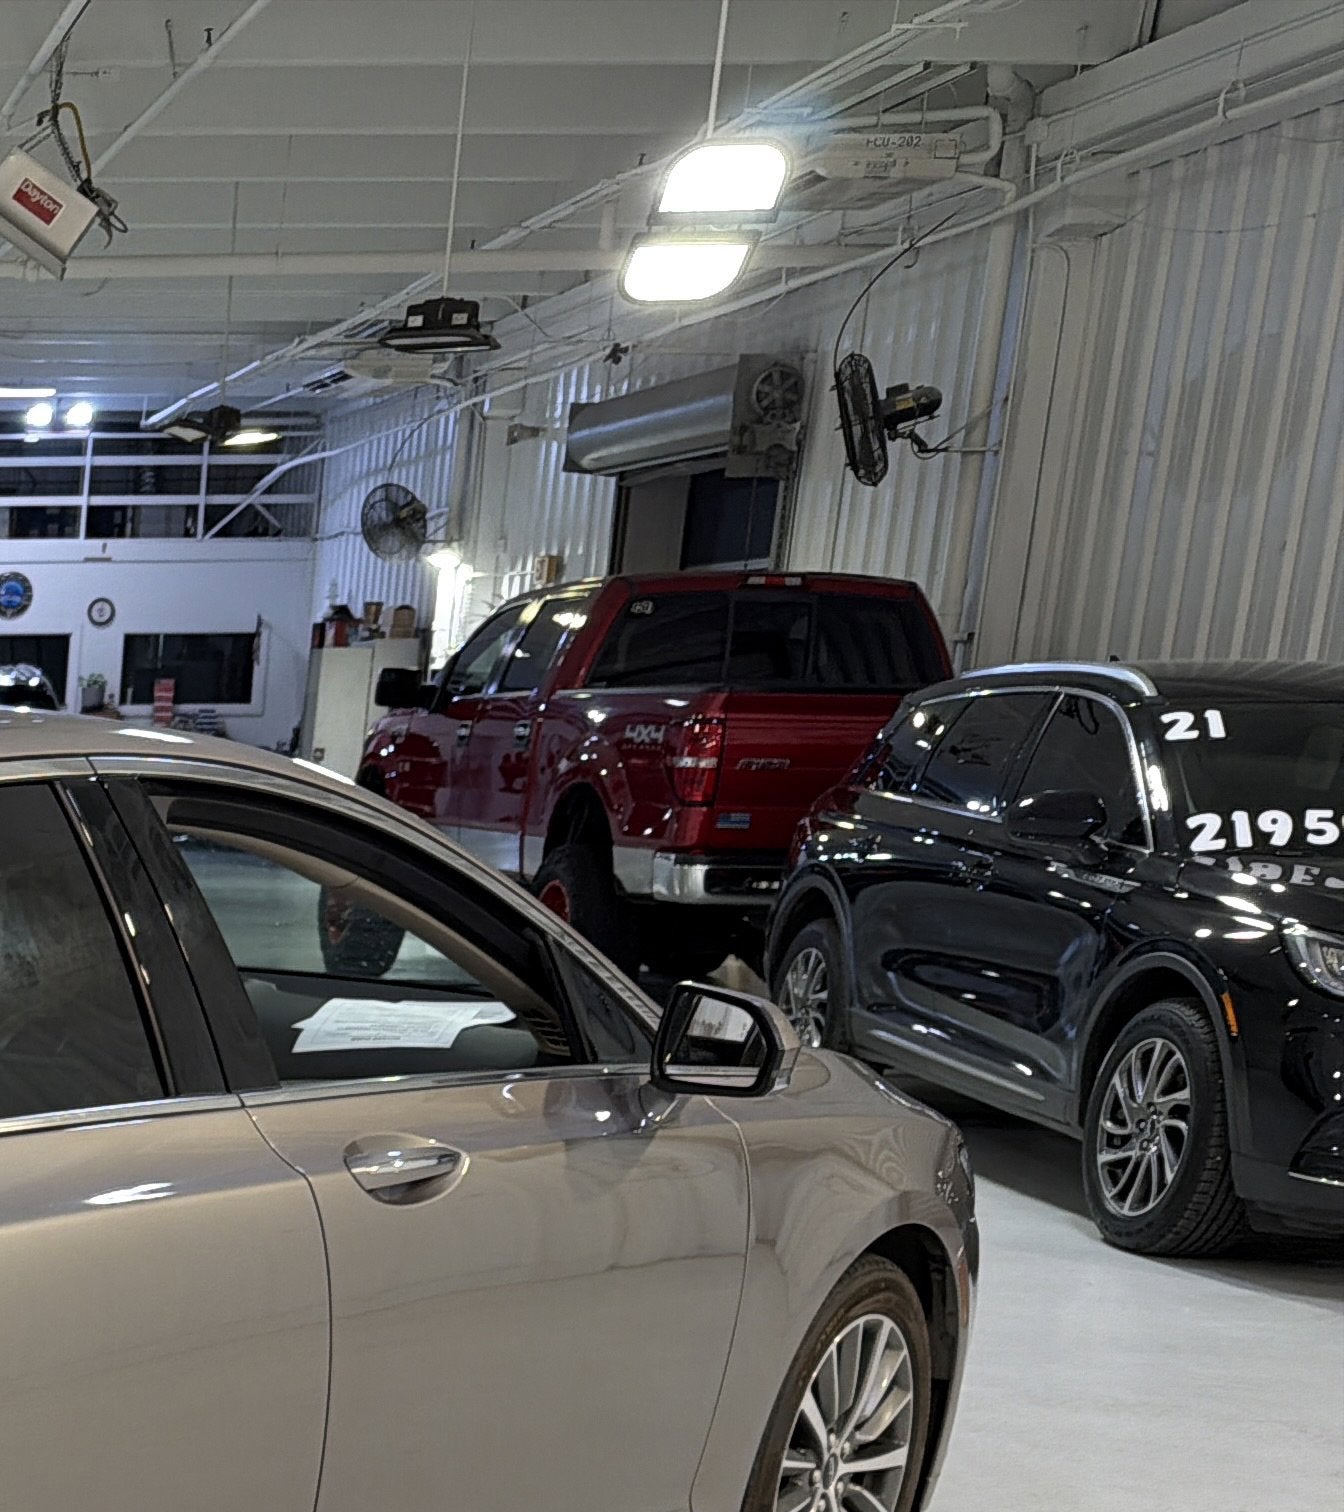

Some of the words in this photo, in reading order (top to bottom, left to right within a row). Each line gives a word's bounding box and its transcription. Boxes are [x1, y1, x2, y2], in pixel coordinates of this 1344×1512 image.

[21, 180, 61, 215] Dayton
[1160, 709, 1227, 741] 21
[1185, 809, 1344, 852] 2195
